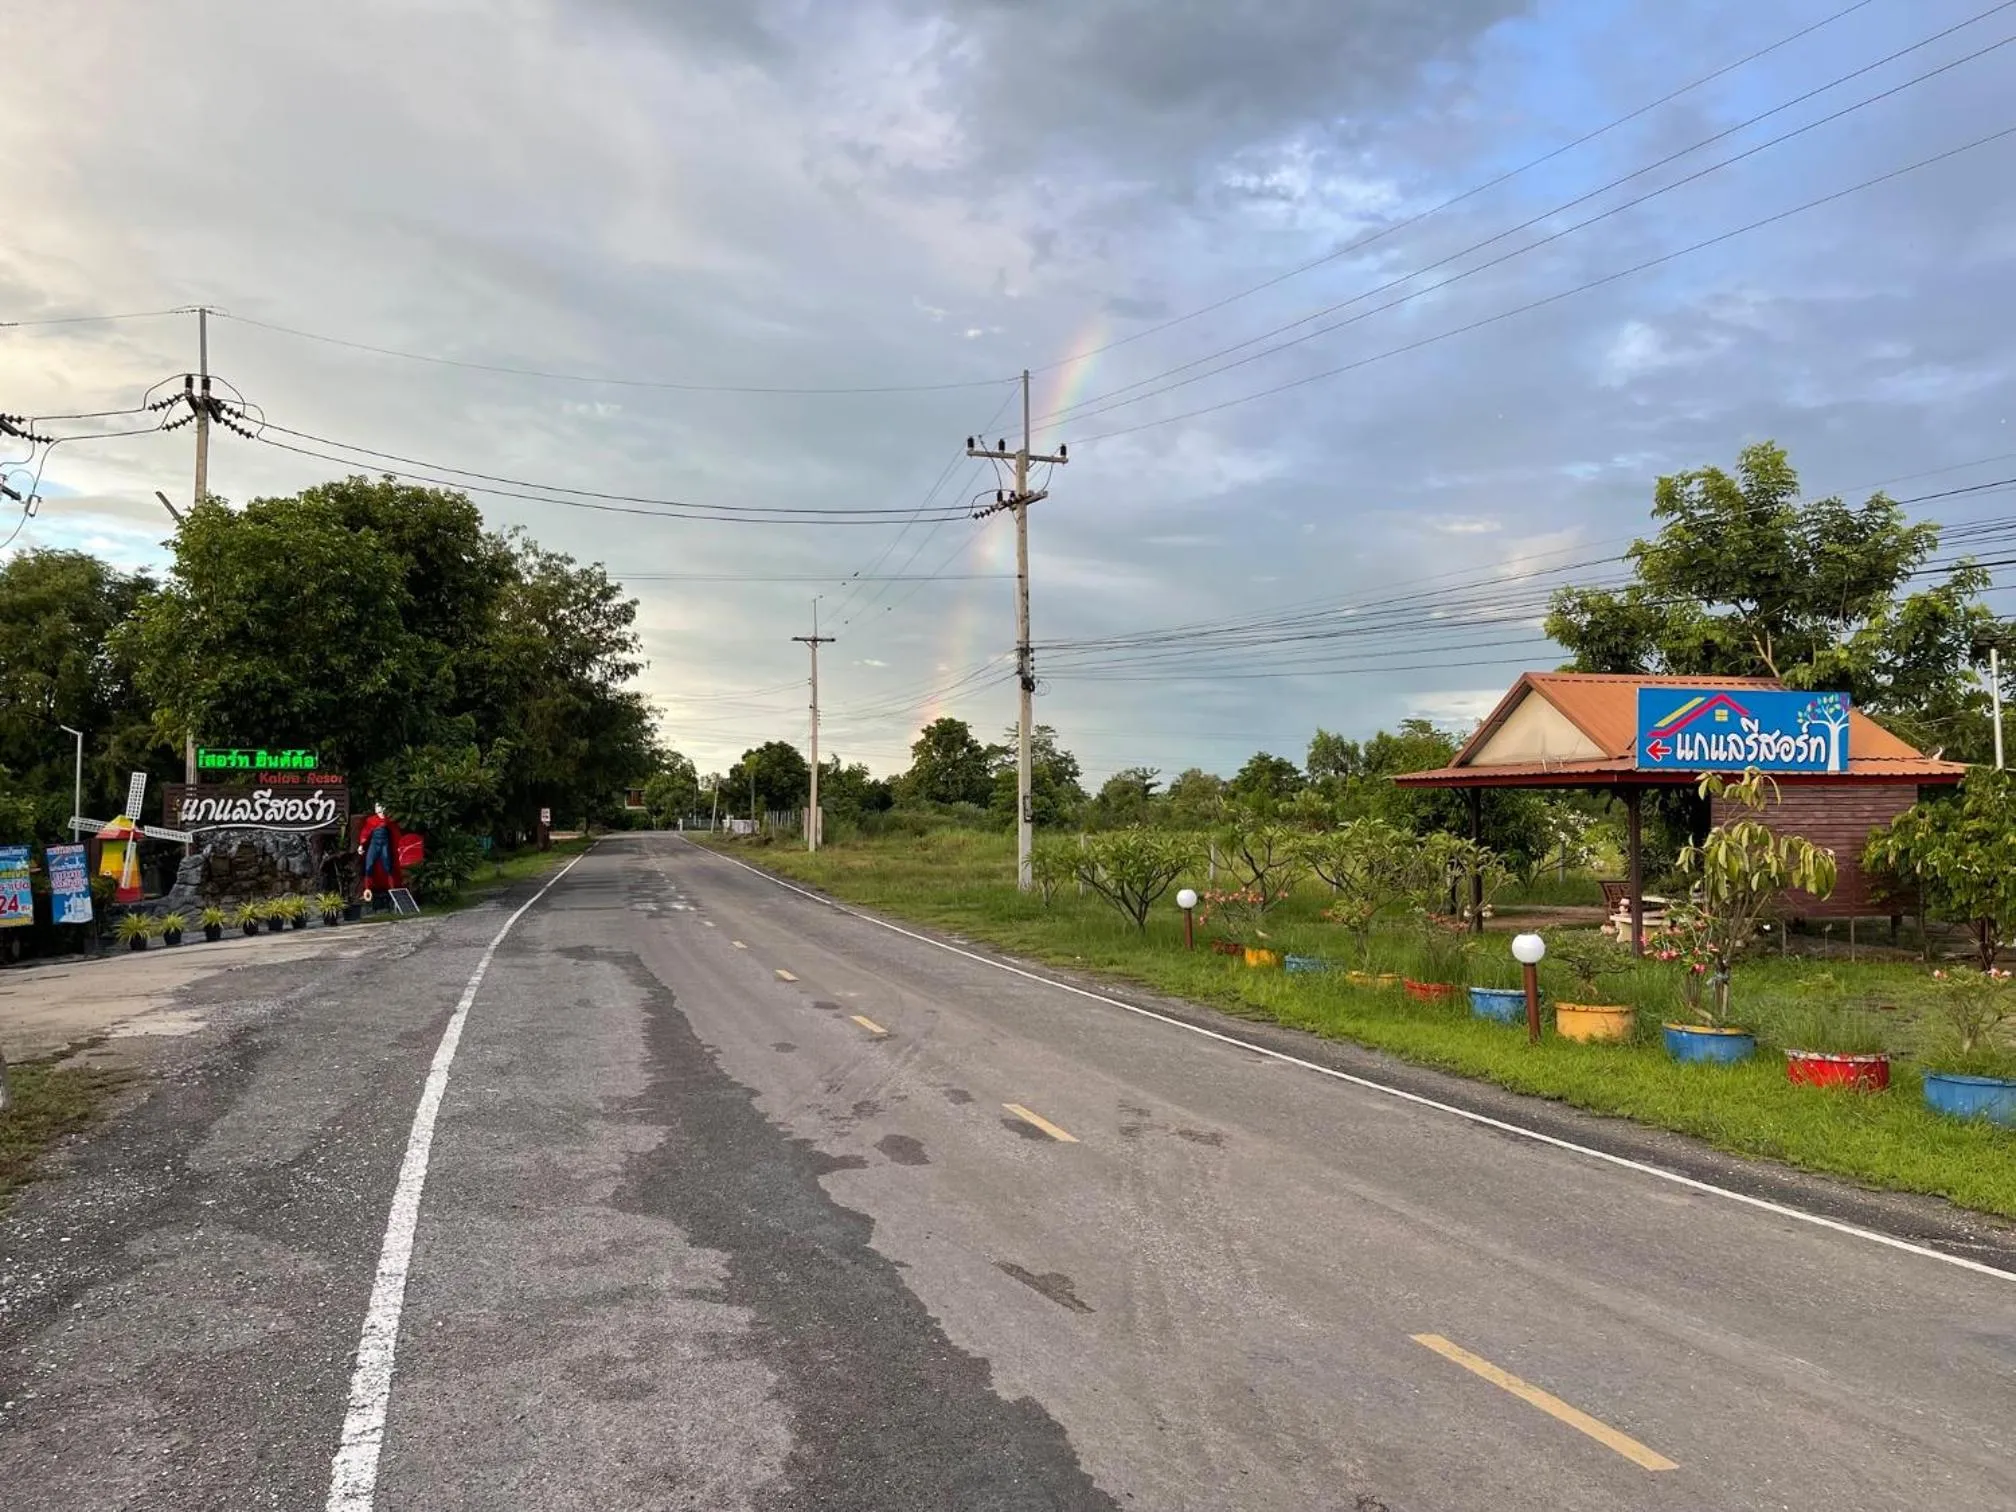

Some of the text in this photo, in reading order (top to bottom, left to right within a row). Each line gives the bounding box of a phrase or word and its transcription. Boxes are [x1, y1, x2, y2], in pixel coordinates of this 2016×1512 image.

[1677, 716, 1826, 763] แกแลรีสอร์ท
[181, 789, 335, 821] แกแลรีสอร์ท
